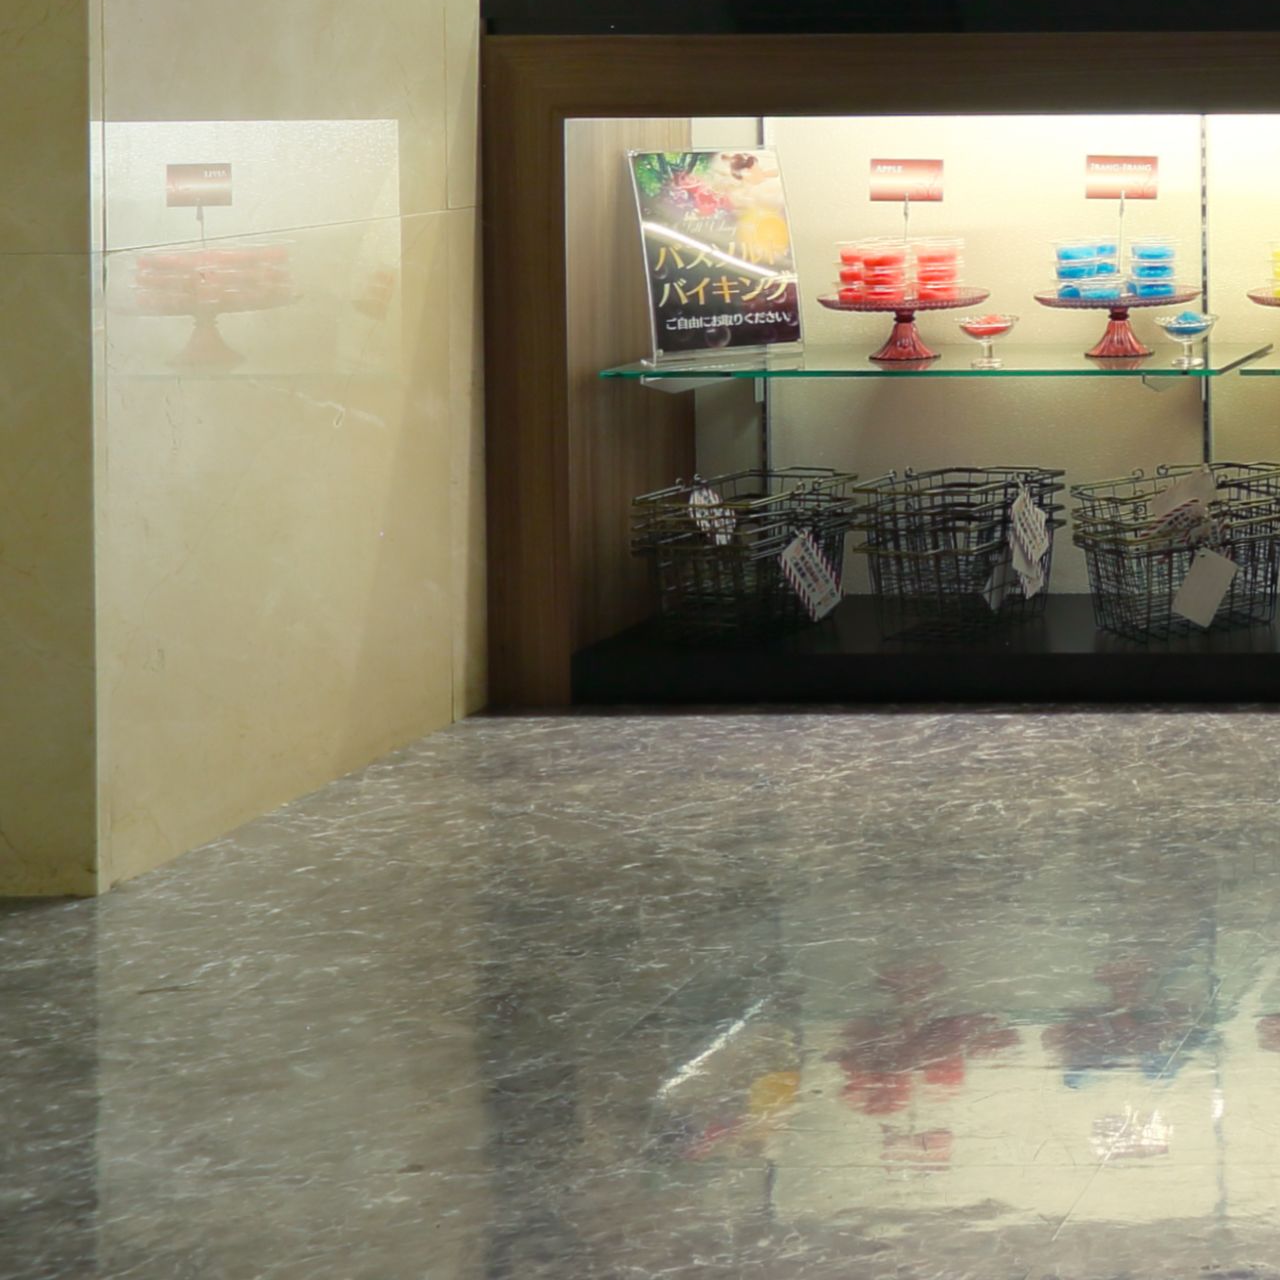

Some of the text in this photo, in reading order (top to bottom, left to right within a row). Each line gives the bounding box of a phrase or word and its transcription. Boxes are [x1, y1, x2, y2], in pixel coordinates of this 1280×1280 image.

[666, 310, 791, 331] ご自由にお取りください
